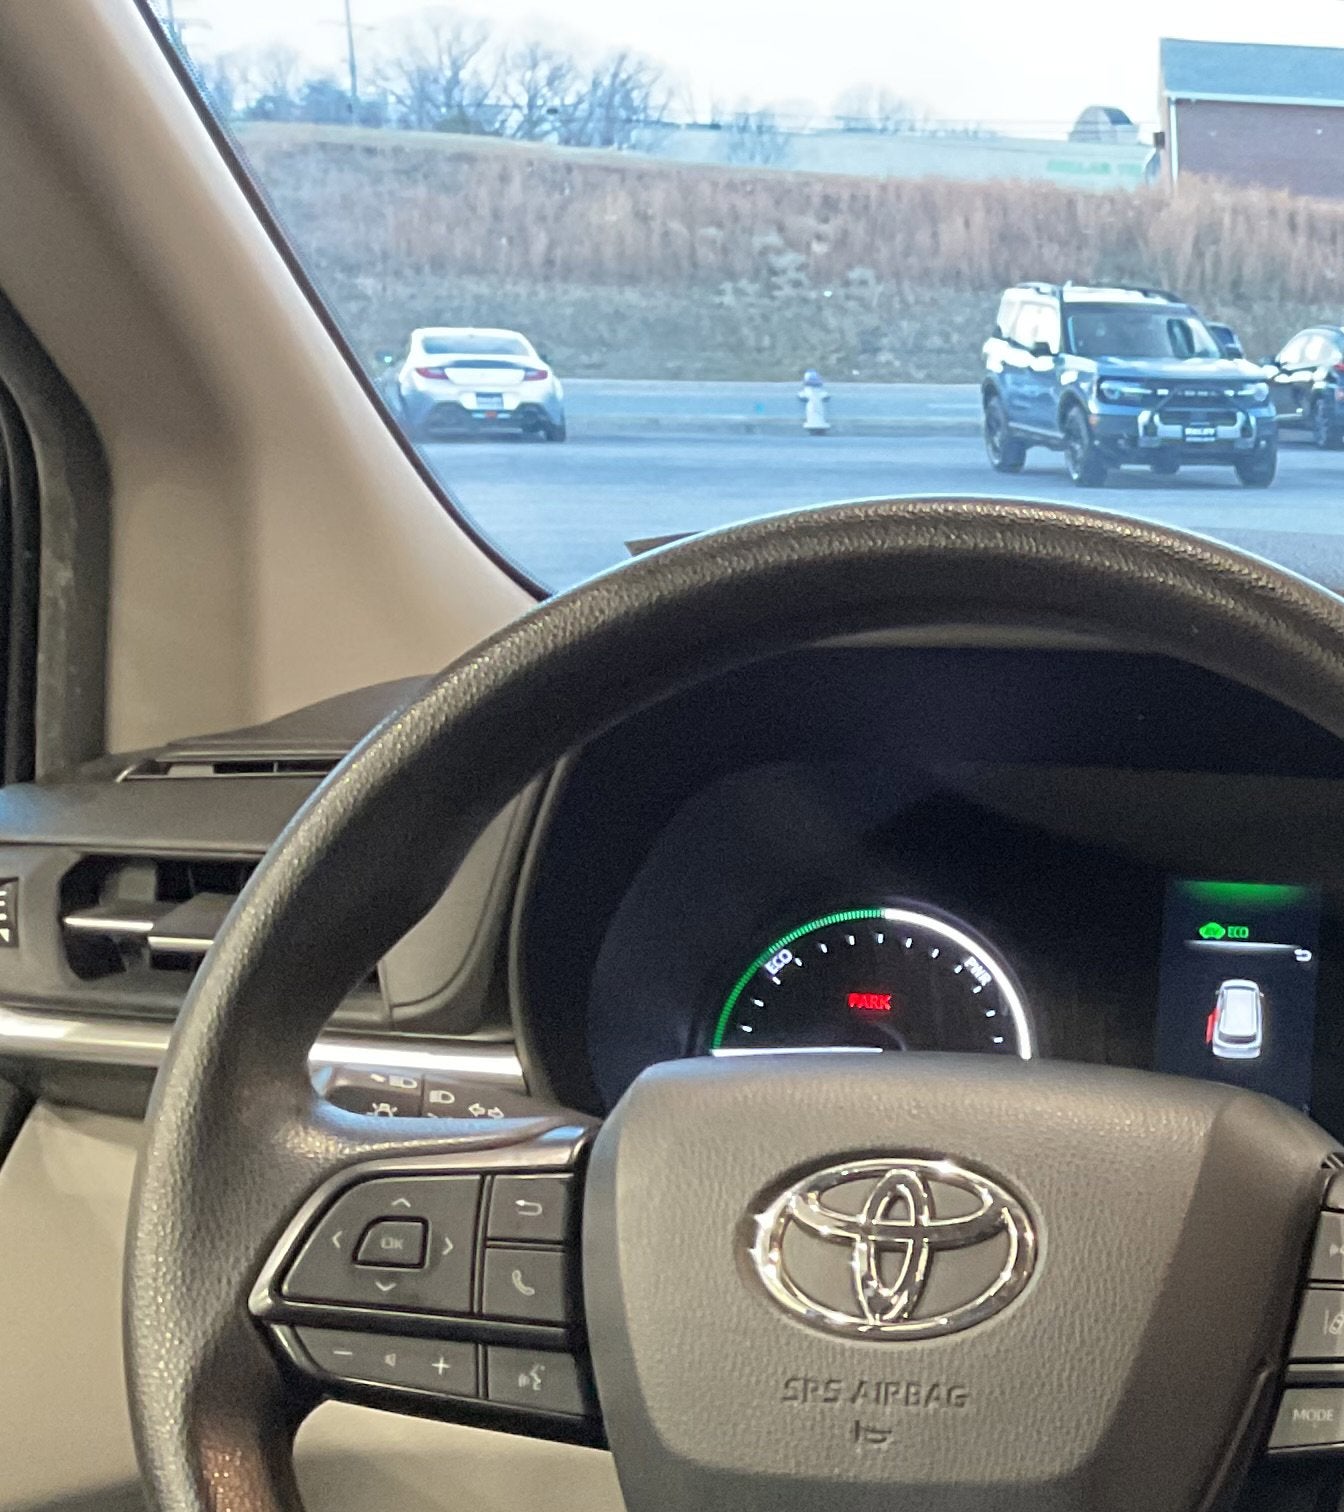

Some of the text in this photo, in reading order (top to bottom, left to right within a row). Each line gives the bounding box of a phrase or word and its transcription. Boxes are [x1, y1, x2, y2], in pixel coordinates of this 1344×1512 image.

[1227, 926, 1249, 939] ECO
[765, 948, 793, 976] ECO
[848, 993, 892, 1011] PARK
[381, 1236, 404, 1250] OK
[782, 1377, 970, 1409] SRS AIRBAG
[1293, 1409, 1334, 1422] MODE
